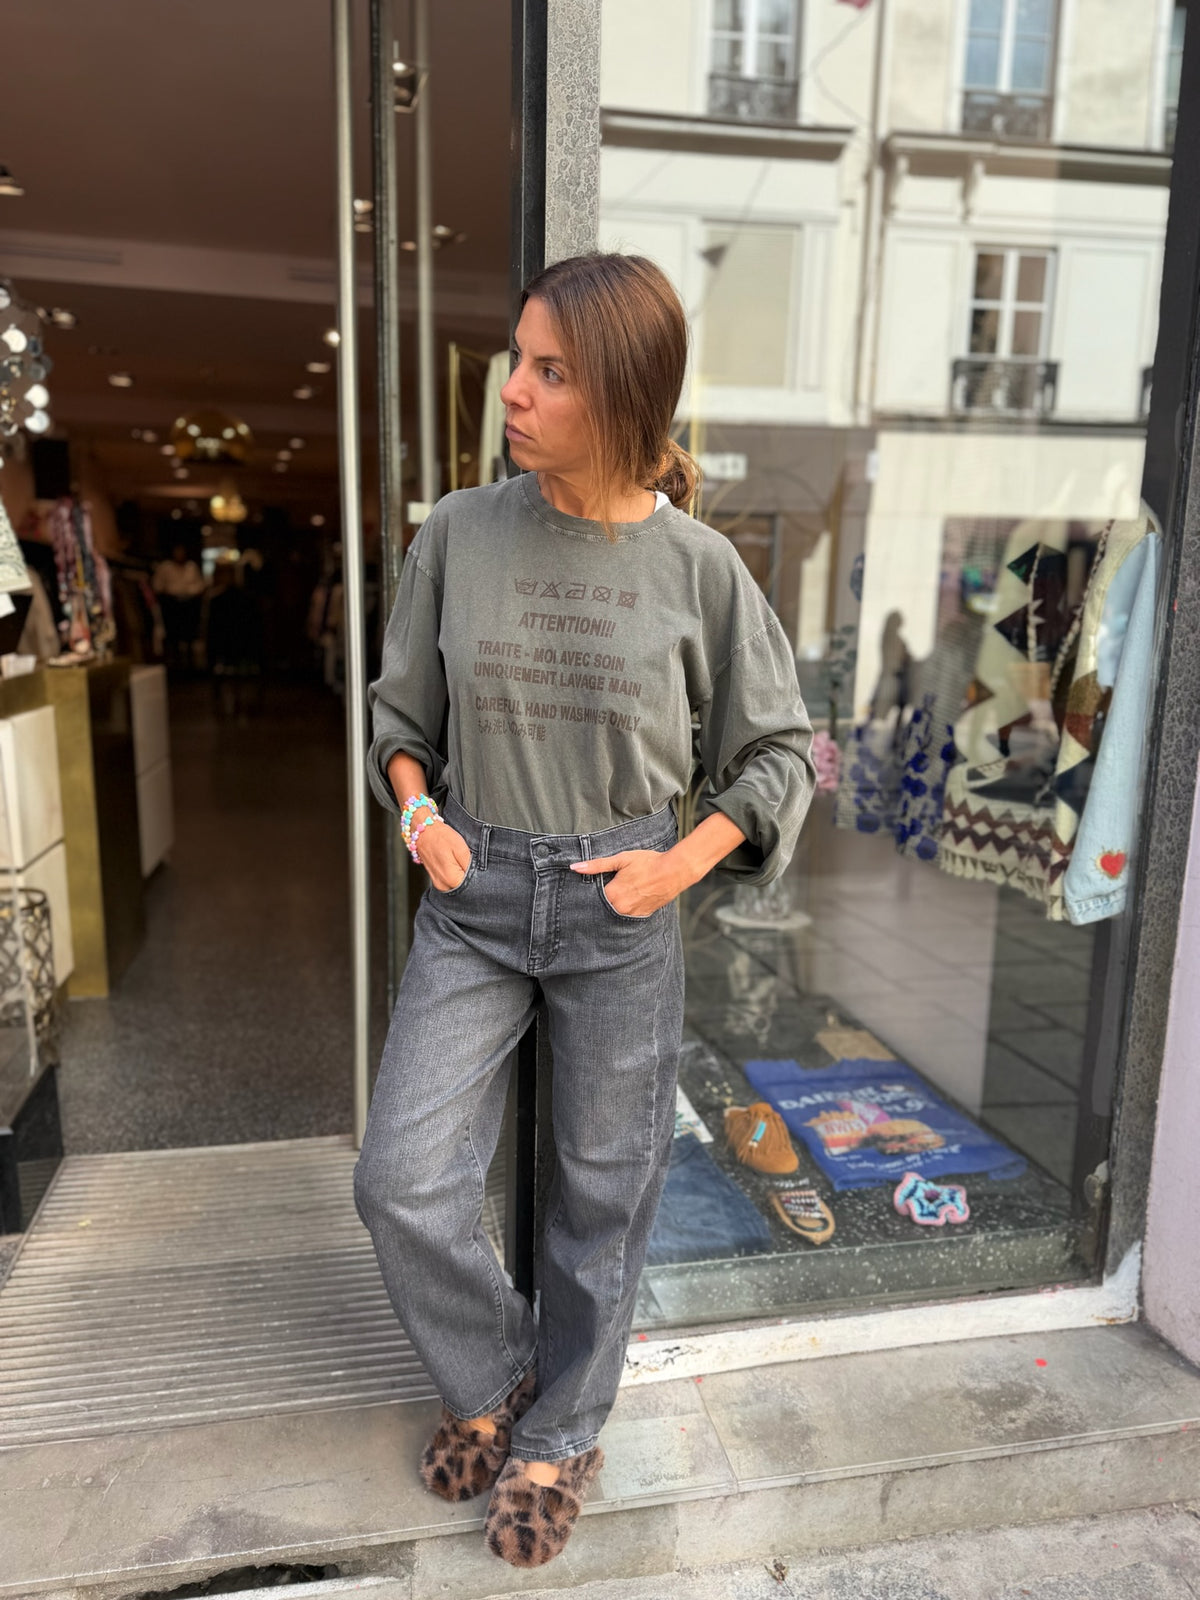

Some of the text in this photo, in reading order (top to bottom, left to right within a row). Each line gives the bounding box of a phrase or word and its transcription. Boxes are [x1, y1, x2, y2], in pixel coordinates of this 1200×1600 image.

[518, 612, 617, 638] ATTENTION!!!
[477, 640, 522, 658] TRAITE
[533, 647, 557, 664] MOI
[559, 650, 591, 667] AVEC
[594, 653, 626, 672] SOIN
[474, 662, 641, 698] UNIQUEMENT LAVAGE MAIN
[475, 696, 641, 732] CAREFUL HAND WASHING ONLY
